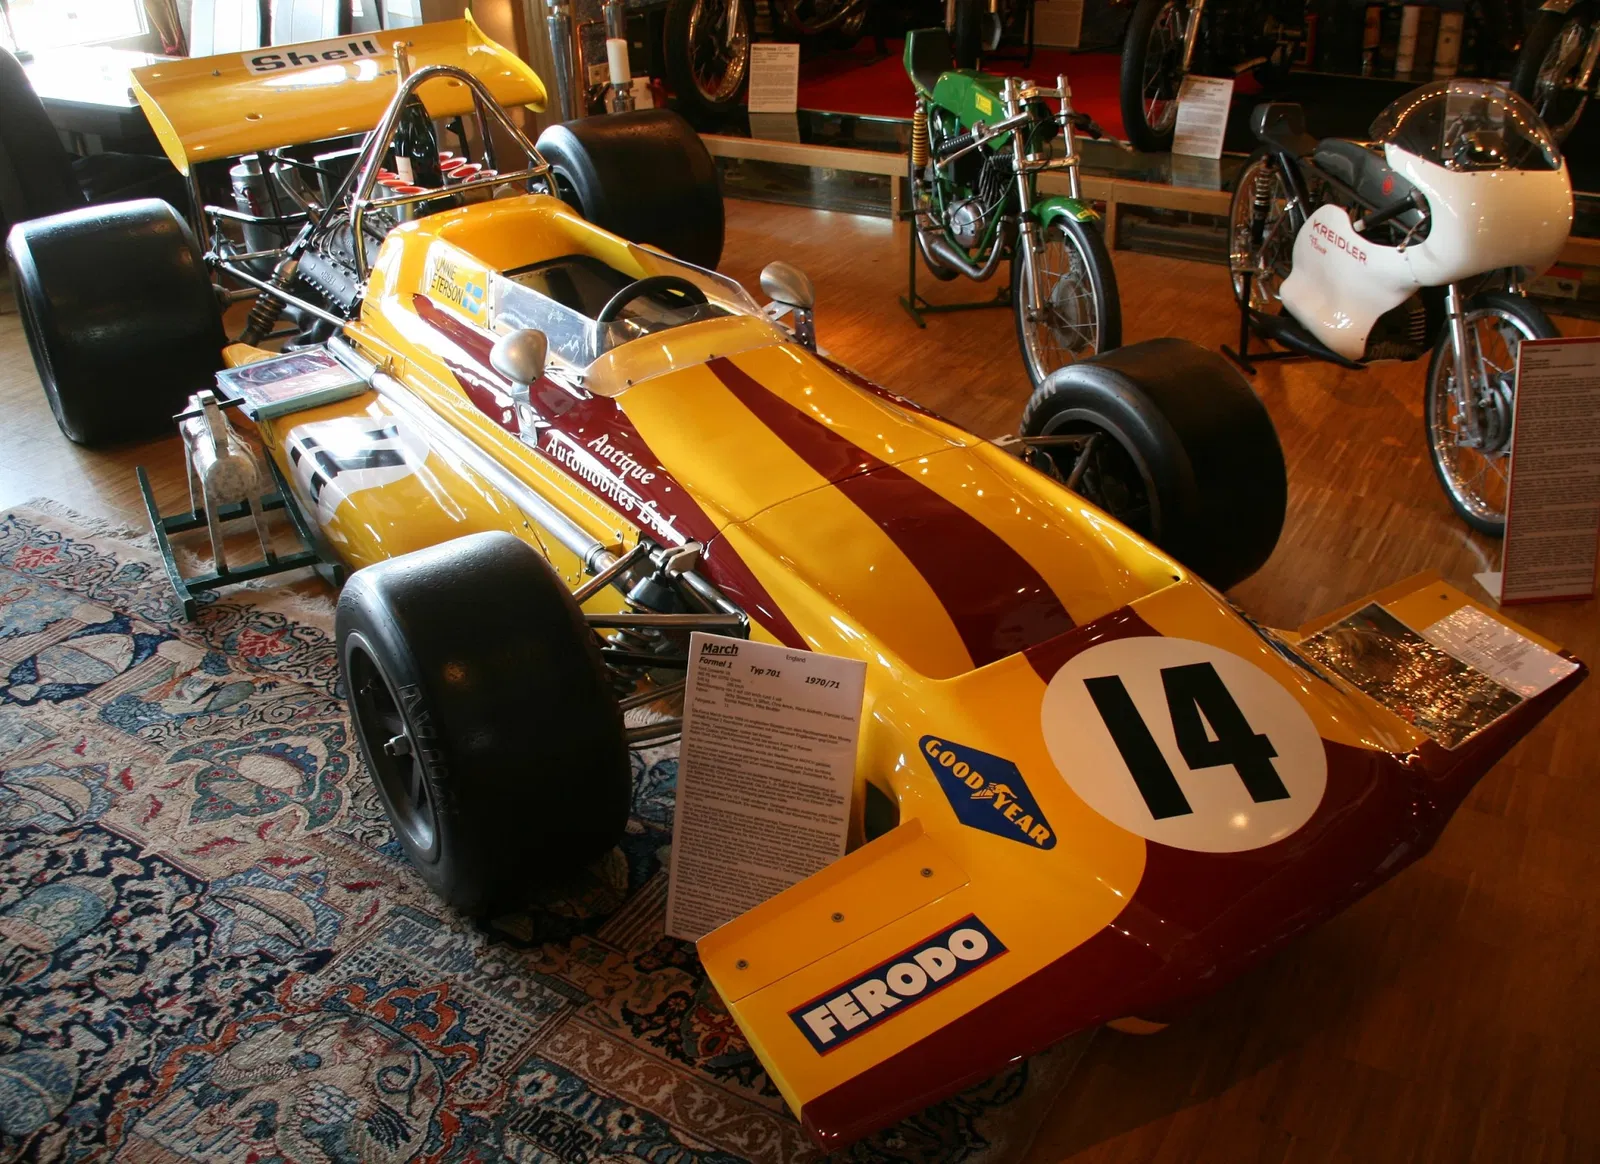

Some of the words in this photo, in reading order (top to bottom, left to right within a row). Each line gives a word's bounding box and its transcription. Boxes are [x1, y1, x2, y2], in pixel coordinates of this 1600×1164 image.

[251, 40, 378, 72] Shell
[1313, 219, 1367, 265] KREIDLER
[430, 272, 464, 305] ETERSON
[587, 433, 656, 485] Antique
[698, 656, 726, 668] Formel
[727, 661, 733, 669] 1
[750, 665, 765, 677] Typ
[766, 668, 781, 678] 701
[805, 676, 840, 689] 1970/71
[701, 643, 739, 656] March
[786, 654, 806, 664] England
[1083, 662, 1291, 820] 14
[802, 928, 989, 1044] FERODO
